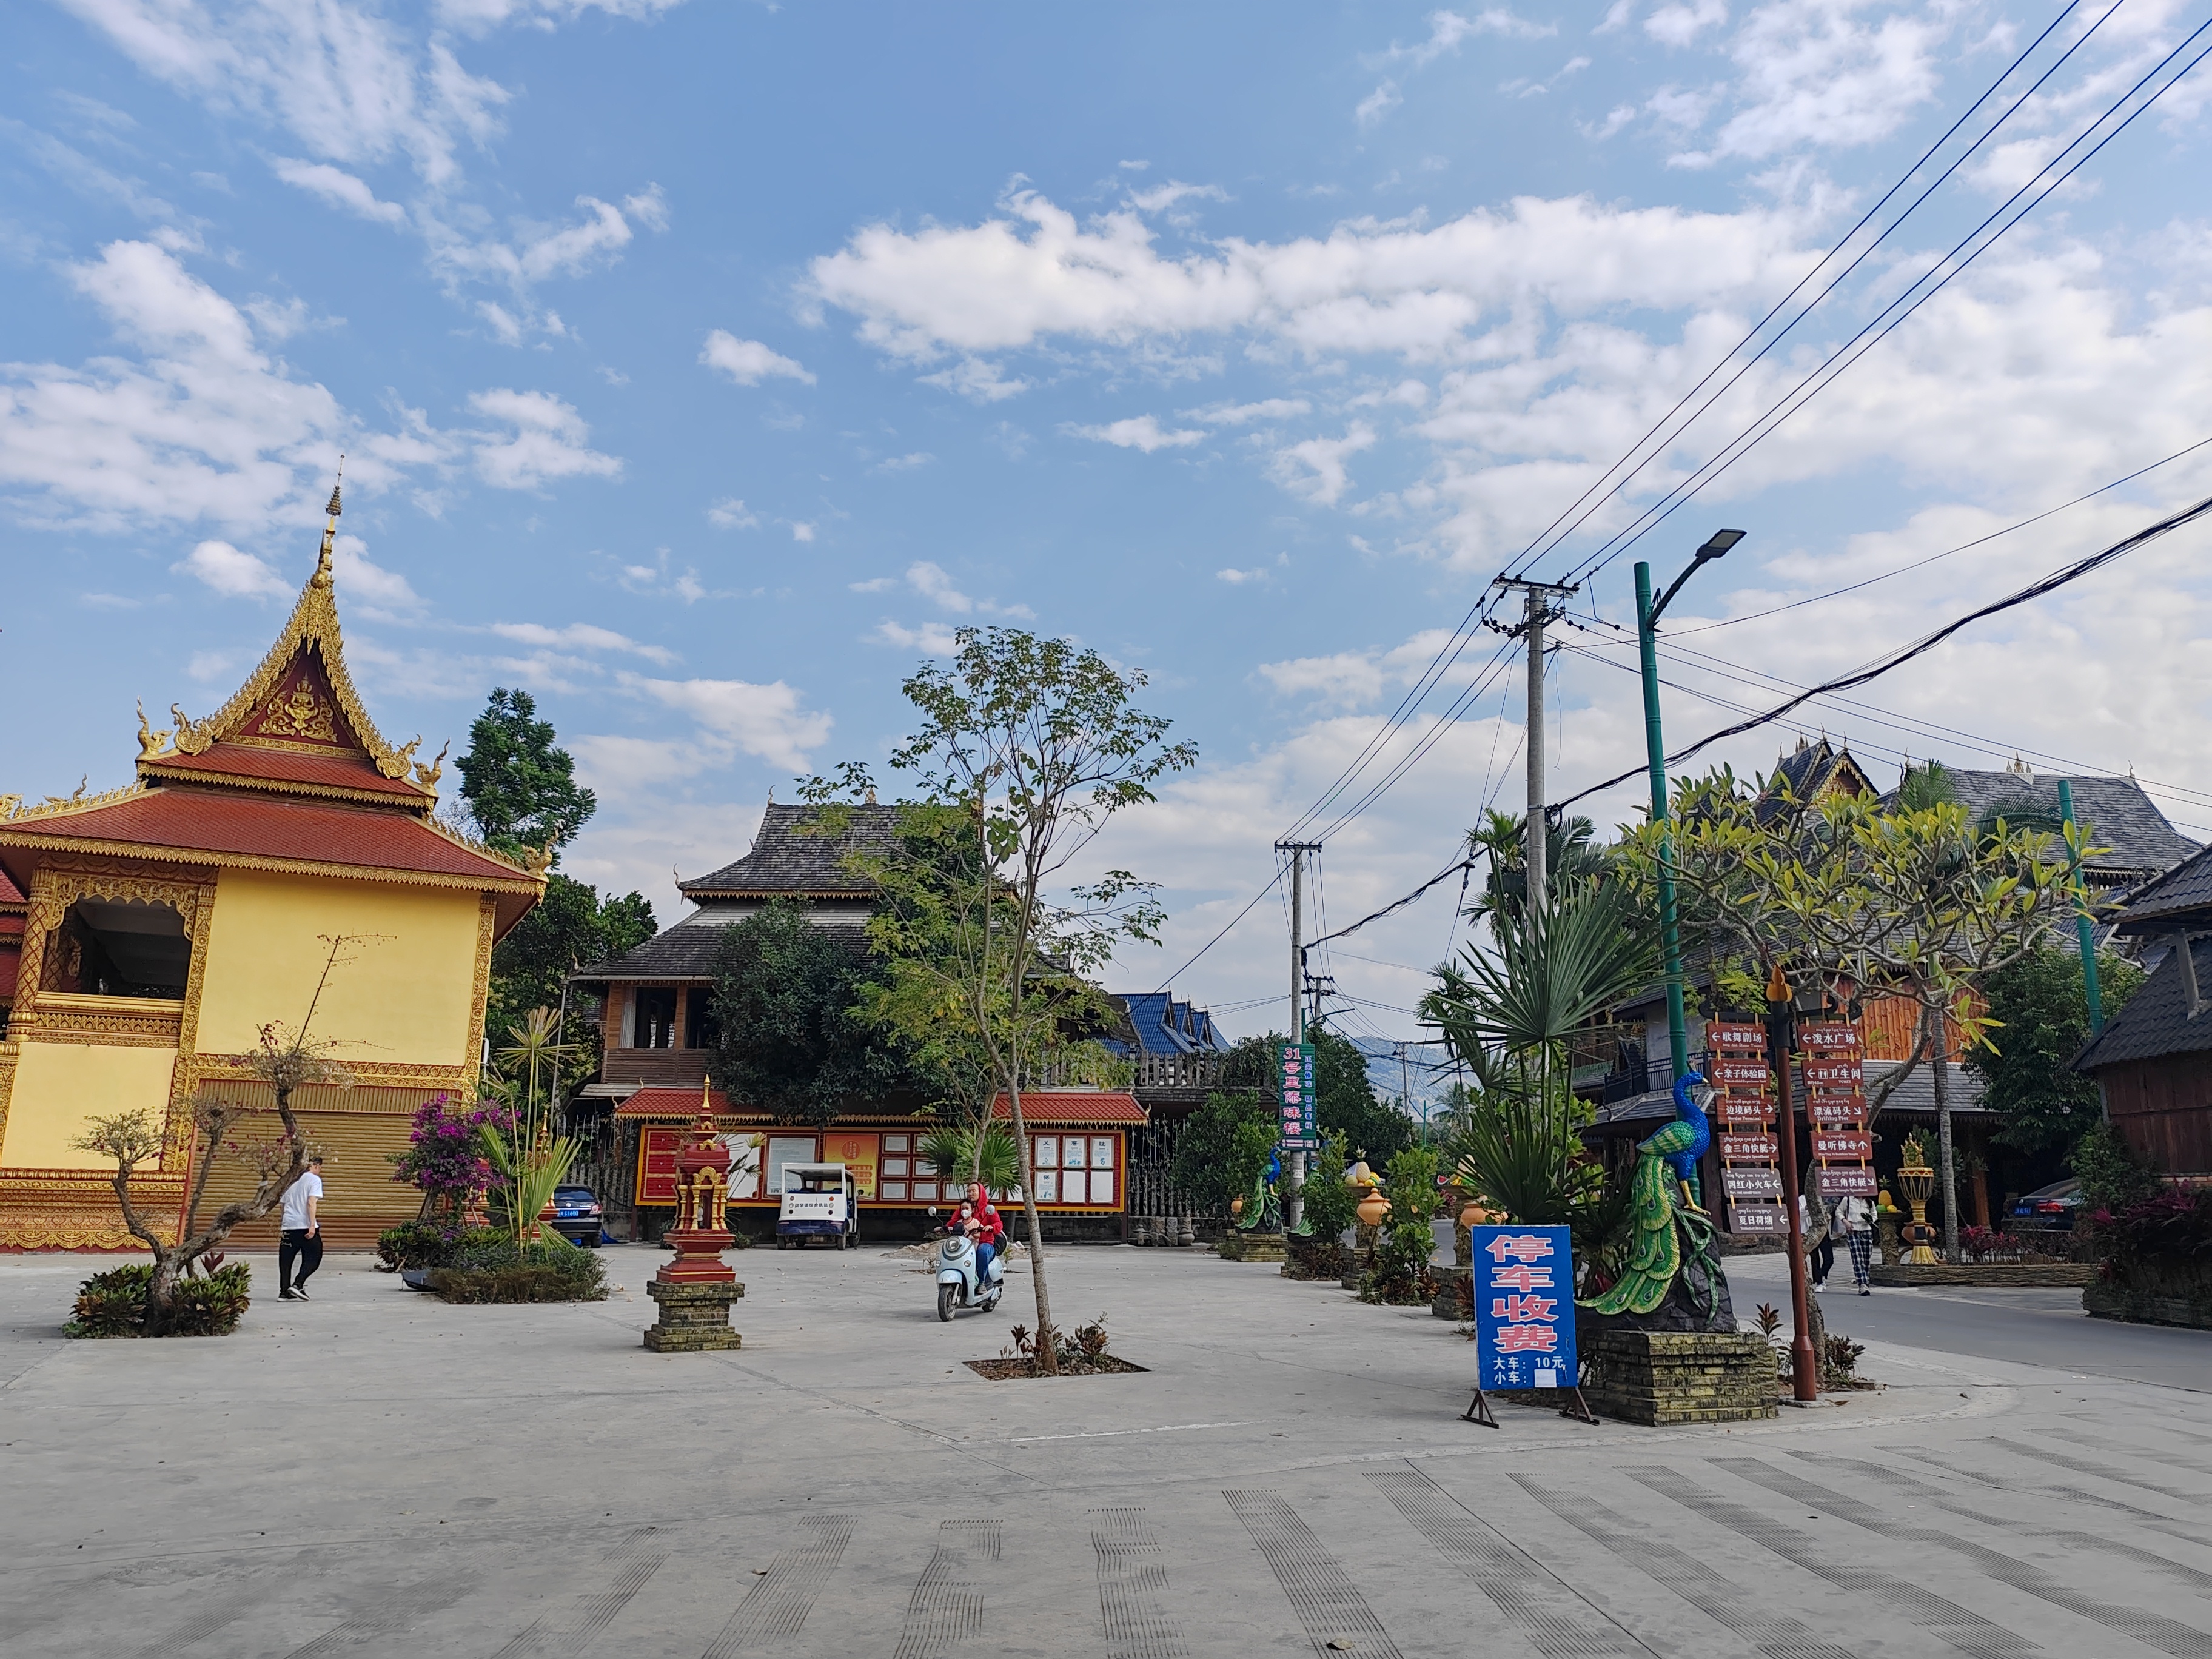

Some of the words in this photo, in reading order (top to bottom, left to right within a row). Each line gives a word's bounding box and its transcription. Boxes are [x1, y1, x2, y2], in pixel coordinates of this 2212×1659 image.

[1722, 1032, 1762, 1043] 歌舞剧场
[1812, 1033, 1855, 1044] 泼水广场
[1724, 1068, 1766, 1079] 亲子体验园
[1829, 1068, 1861, 1079] 卫生间
[1726, 1105, 1761, 1114] 边境码头
[1814, 1106, 1851, 1116] 漂流码头
[1724, 1143, 1769, 1153] 金三角快艇
[1818, 1140, 1857, 1151] 曼听佛寺
[1728, 1179, 1772, 1189] 网红小火车
[1822, 1177, 1866, 1187] 金三角快艇
[1738, 1215, 1773, 1225] 夏日荷塘
[1485, 1235, 1559, 1353] 停车收费
